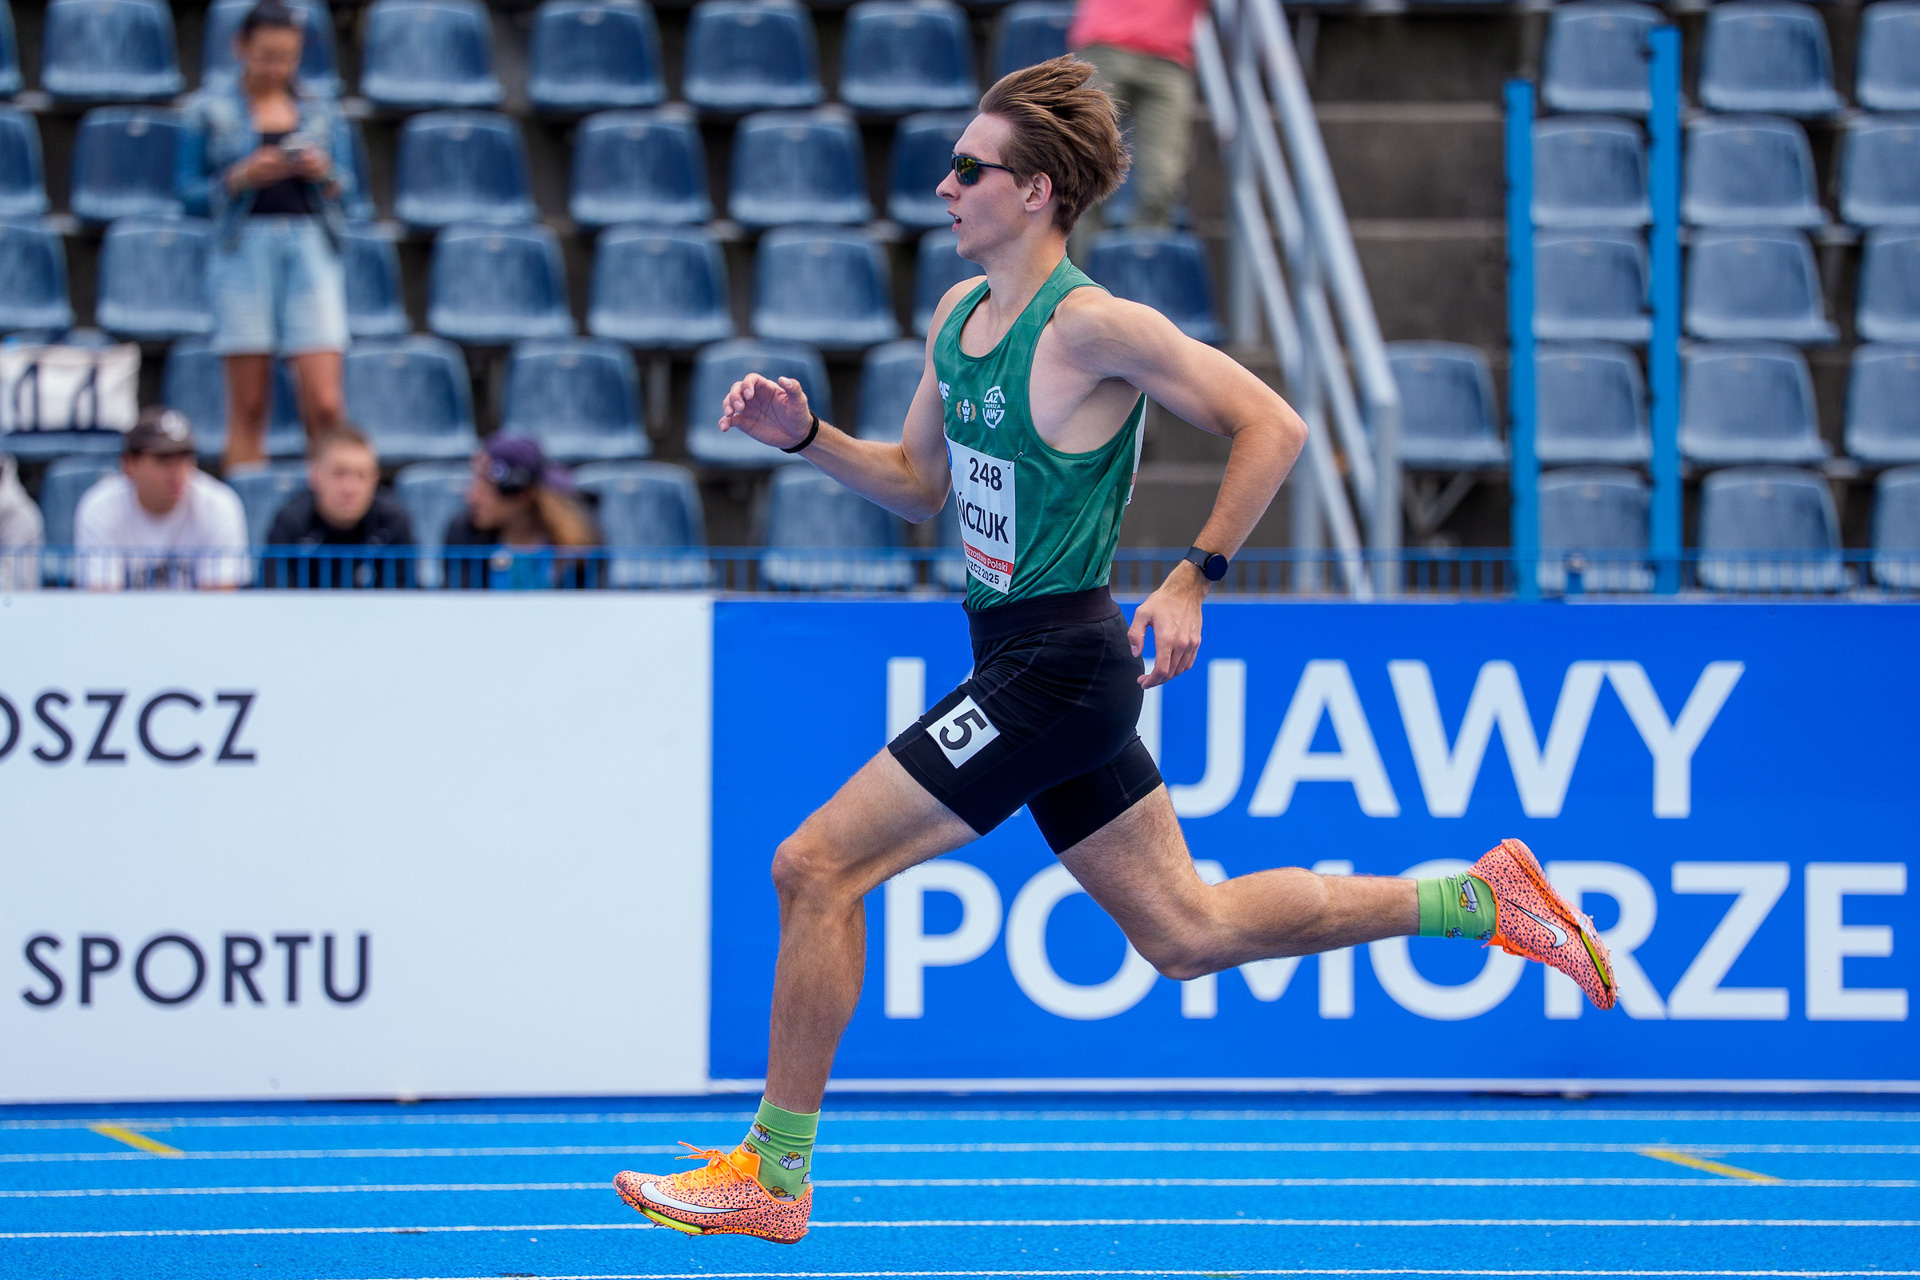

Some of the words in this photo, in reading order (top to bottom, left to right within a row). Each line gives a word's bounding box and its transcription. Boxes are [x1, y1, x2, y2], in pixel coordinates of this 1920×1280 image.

[961, 398, 971, 424] AWF
[969, 457, 1003, 491] 248
[981, 568, 1000, 585] 2025
[987, 558, 1008, 572] Polski
[0, 690, 258, 766] SZCZ
[886, 657, 1746, 819] JAWY
[939, 708, 988, 750] 5
[21, 933, 371, 1008] SPORTU
